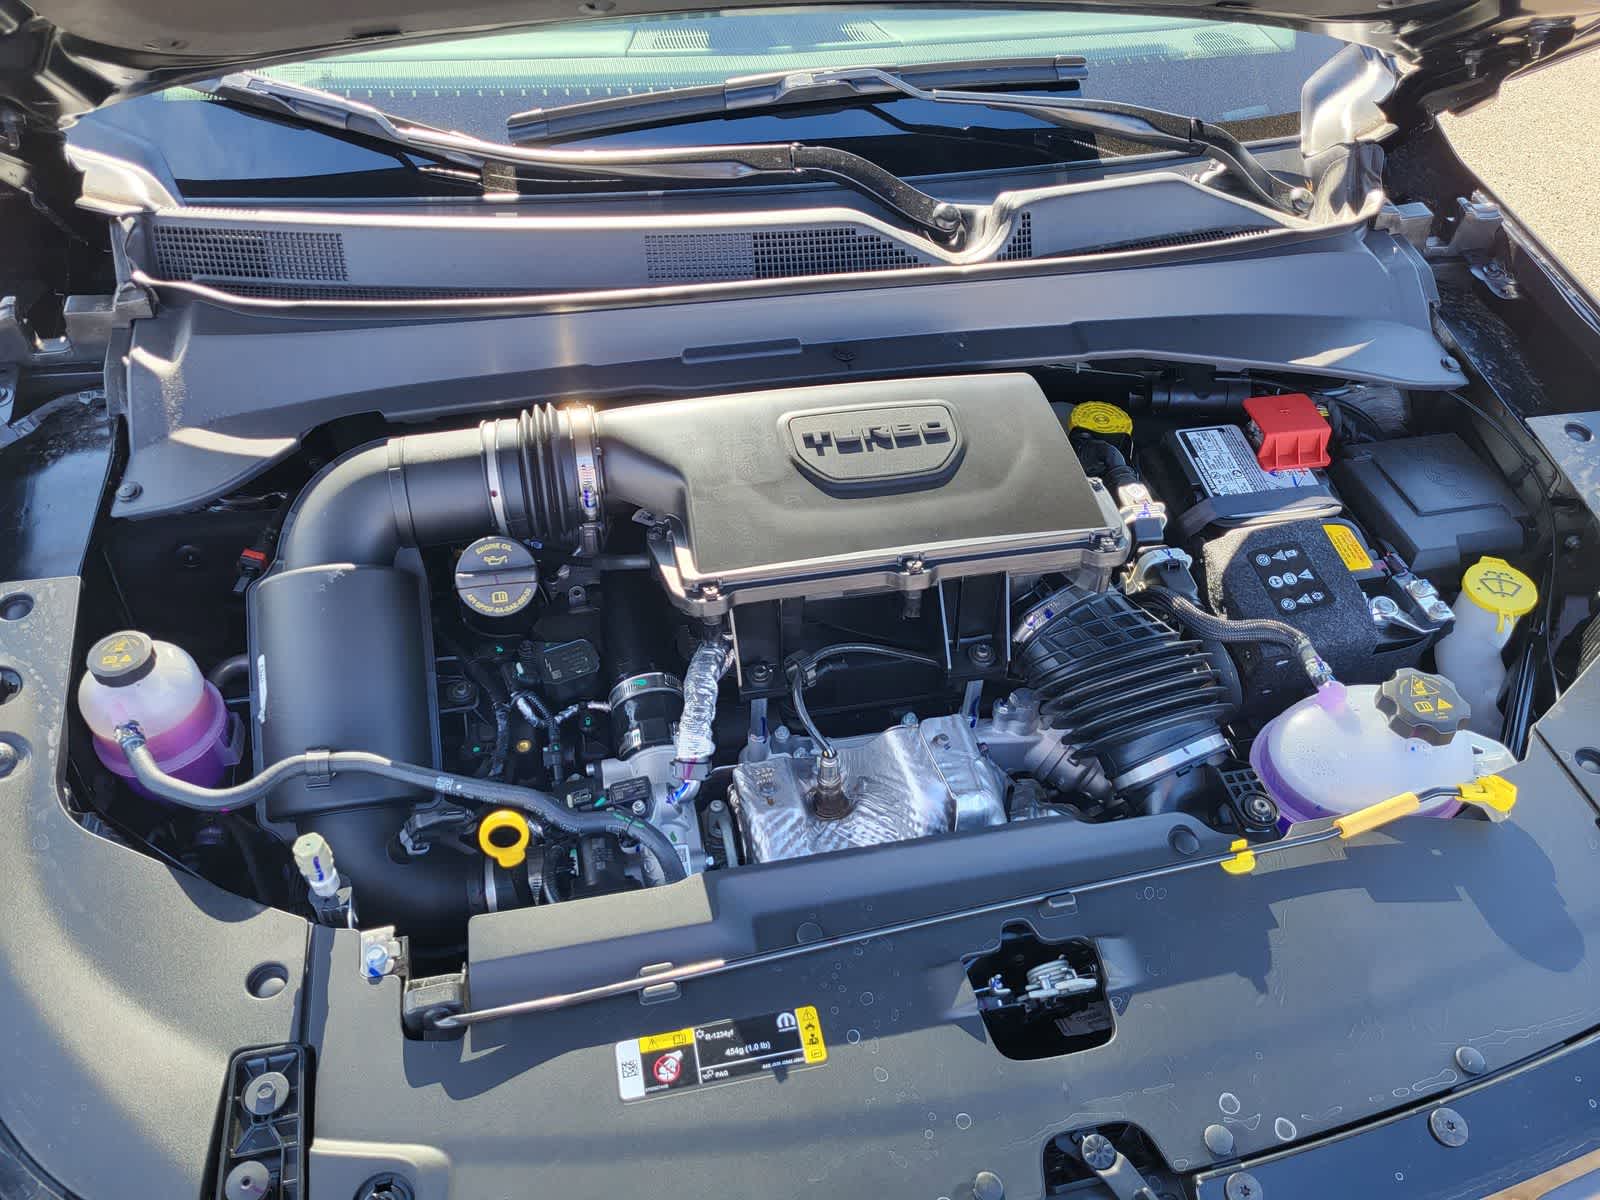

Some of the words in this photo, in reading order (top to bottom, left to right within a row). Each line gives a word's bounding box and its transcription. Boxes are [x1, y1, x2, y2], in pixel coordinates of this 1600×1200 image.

[802, 420, 951, 457] TURBO
[475, 543, 500, 555] ENGINE
[501, 543, 513, 552] OIL
[725, 1046, 745, 1056] 454g
[745, 1043, 759, 1054] (1.0
[760, 1040, 771, 1050] lb)
